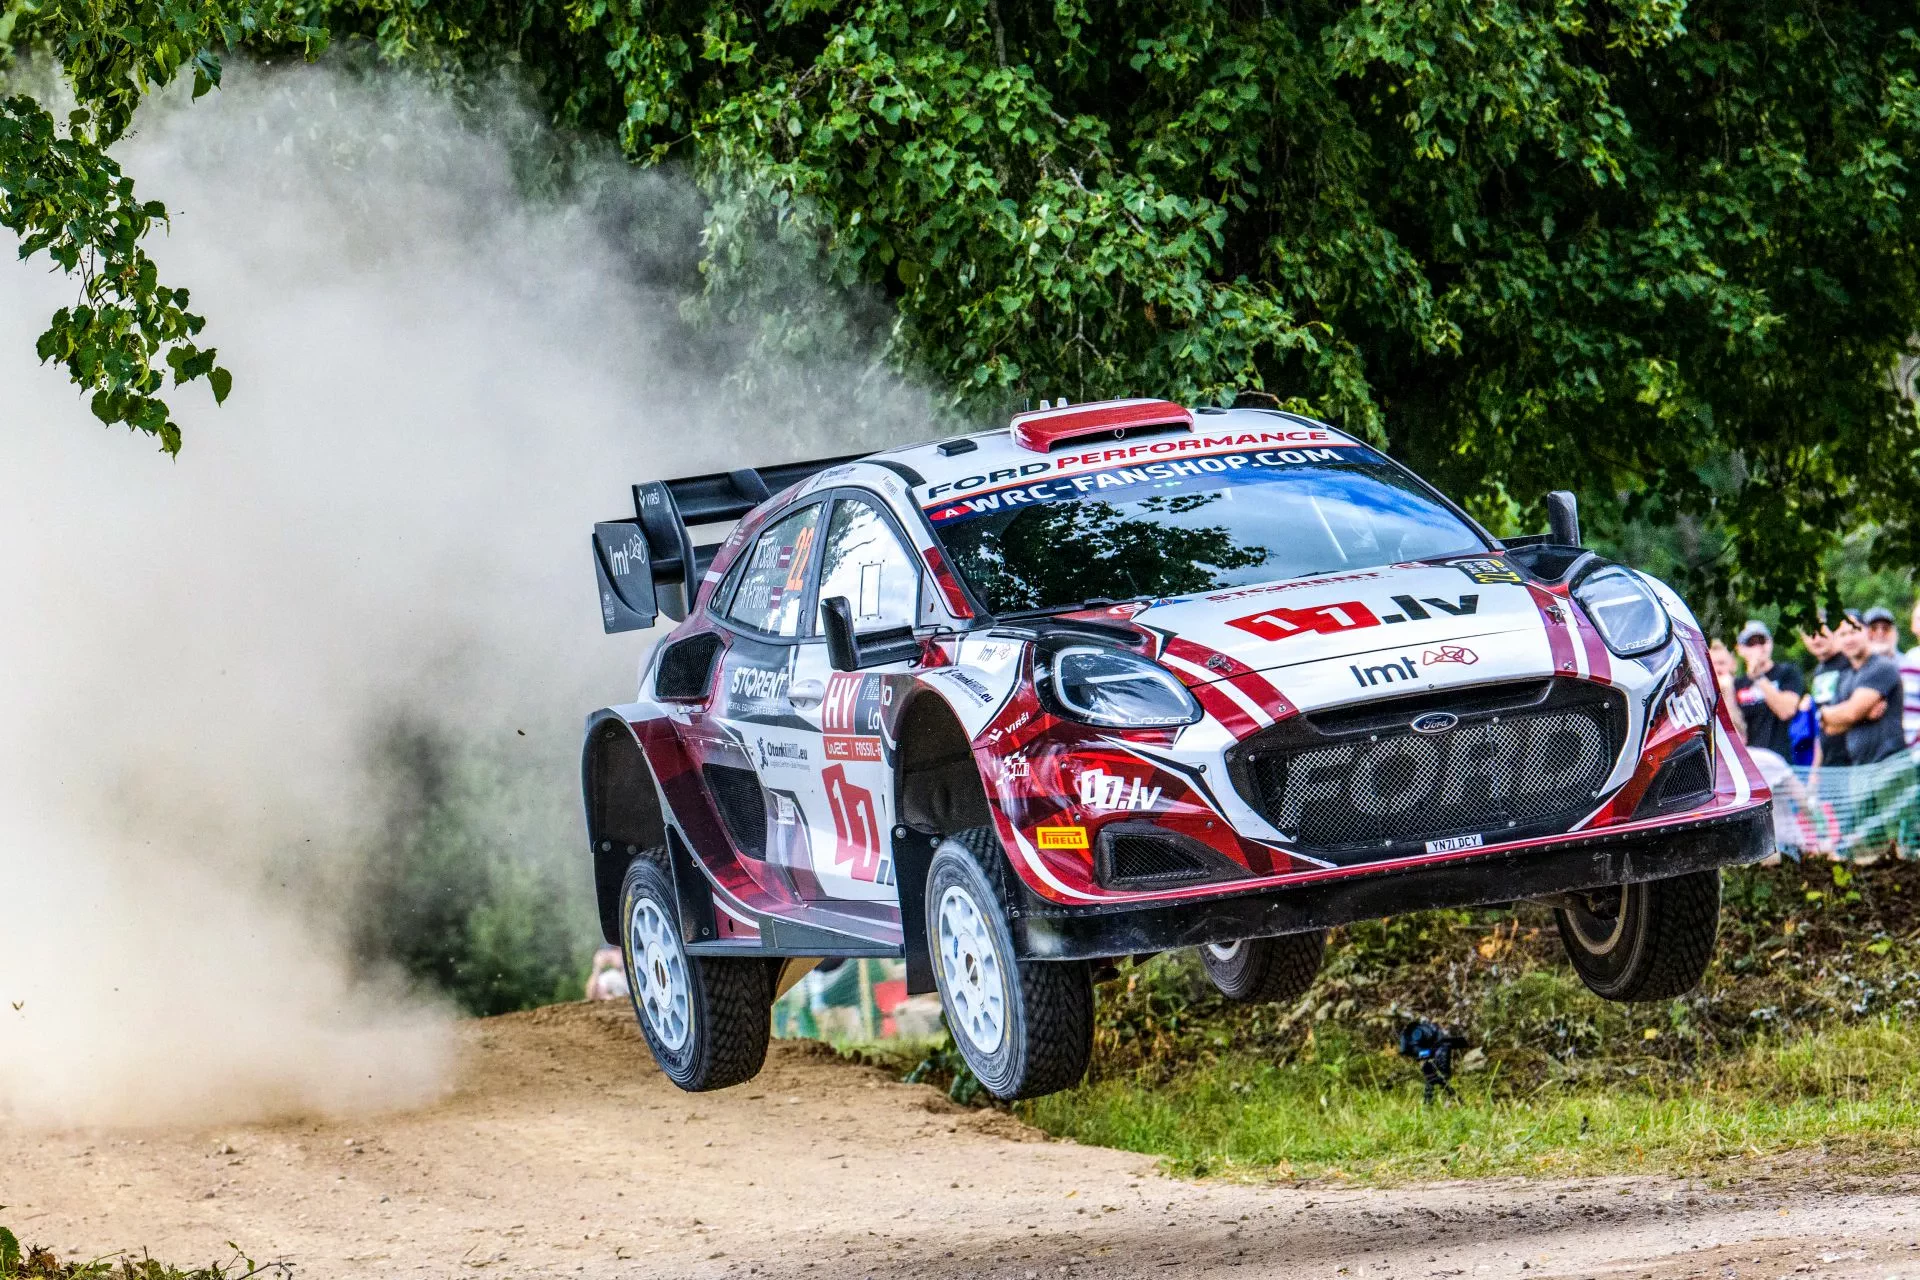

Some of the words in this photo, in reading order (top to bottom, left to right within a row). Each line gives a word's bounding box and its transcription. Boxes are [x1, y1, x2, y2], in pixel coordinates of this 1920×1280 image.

[928, 462, 1051, 499] FORD
[1057, 431, 1329, 469] PERFORMANCE
[962, 448, 1345, 512] WRC-FANSHOP.COM
[609, 545, 629, 576] lmt
[783, 527, 815, 591] 22
[731, 667, 788, 700] STORENT
[1349, 656, 1418, 687] lmt
[826, 677, 860, 729] HY
[1005, 711, 1030, 734] VIRŠI
[1081, 769, 1161, 809] 11.lv
[1278, 713, 1602, 829] FORD
[1042, 832, 1083, 844] PIRELLI
[1433, 840, 1455, 851] YN71
[1458, 836, 1478, 848] DCY
